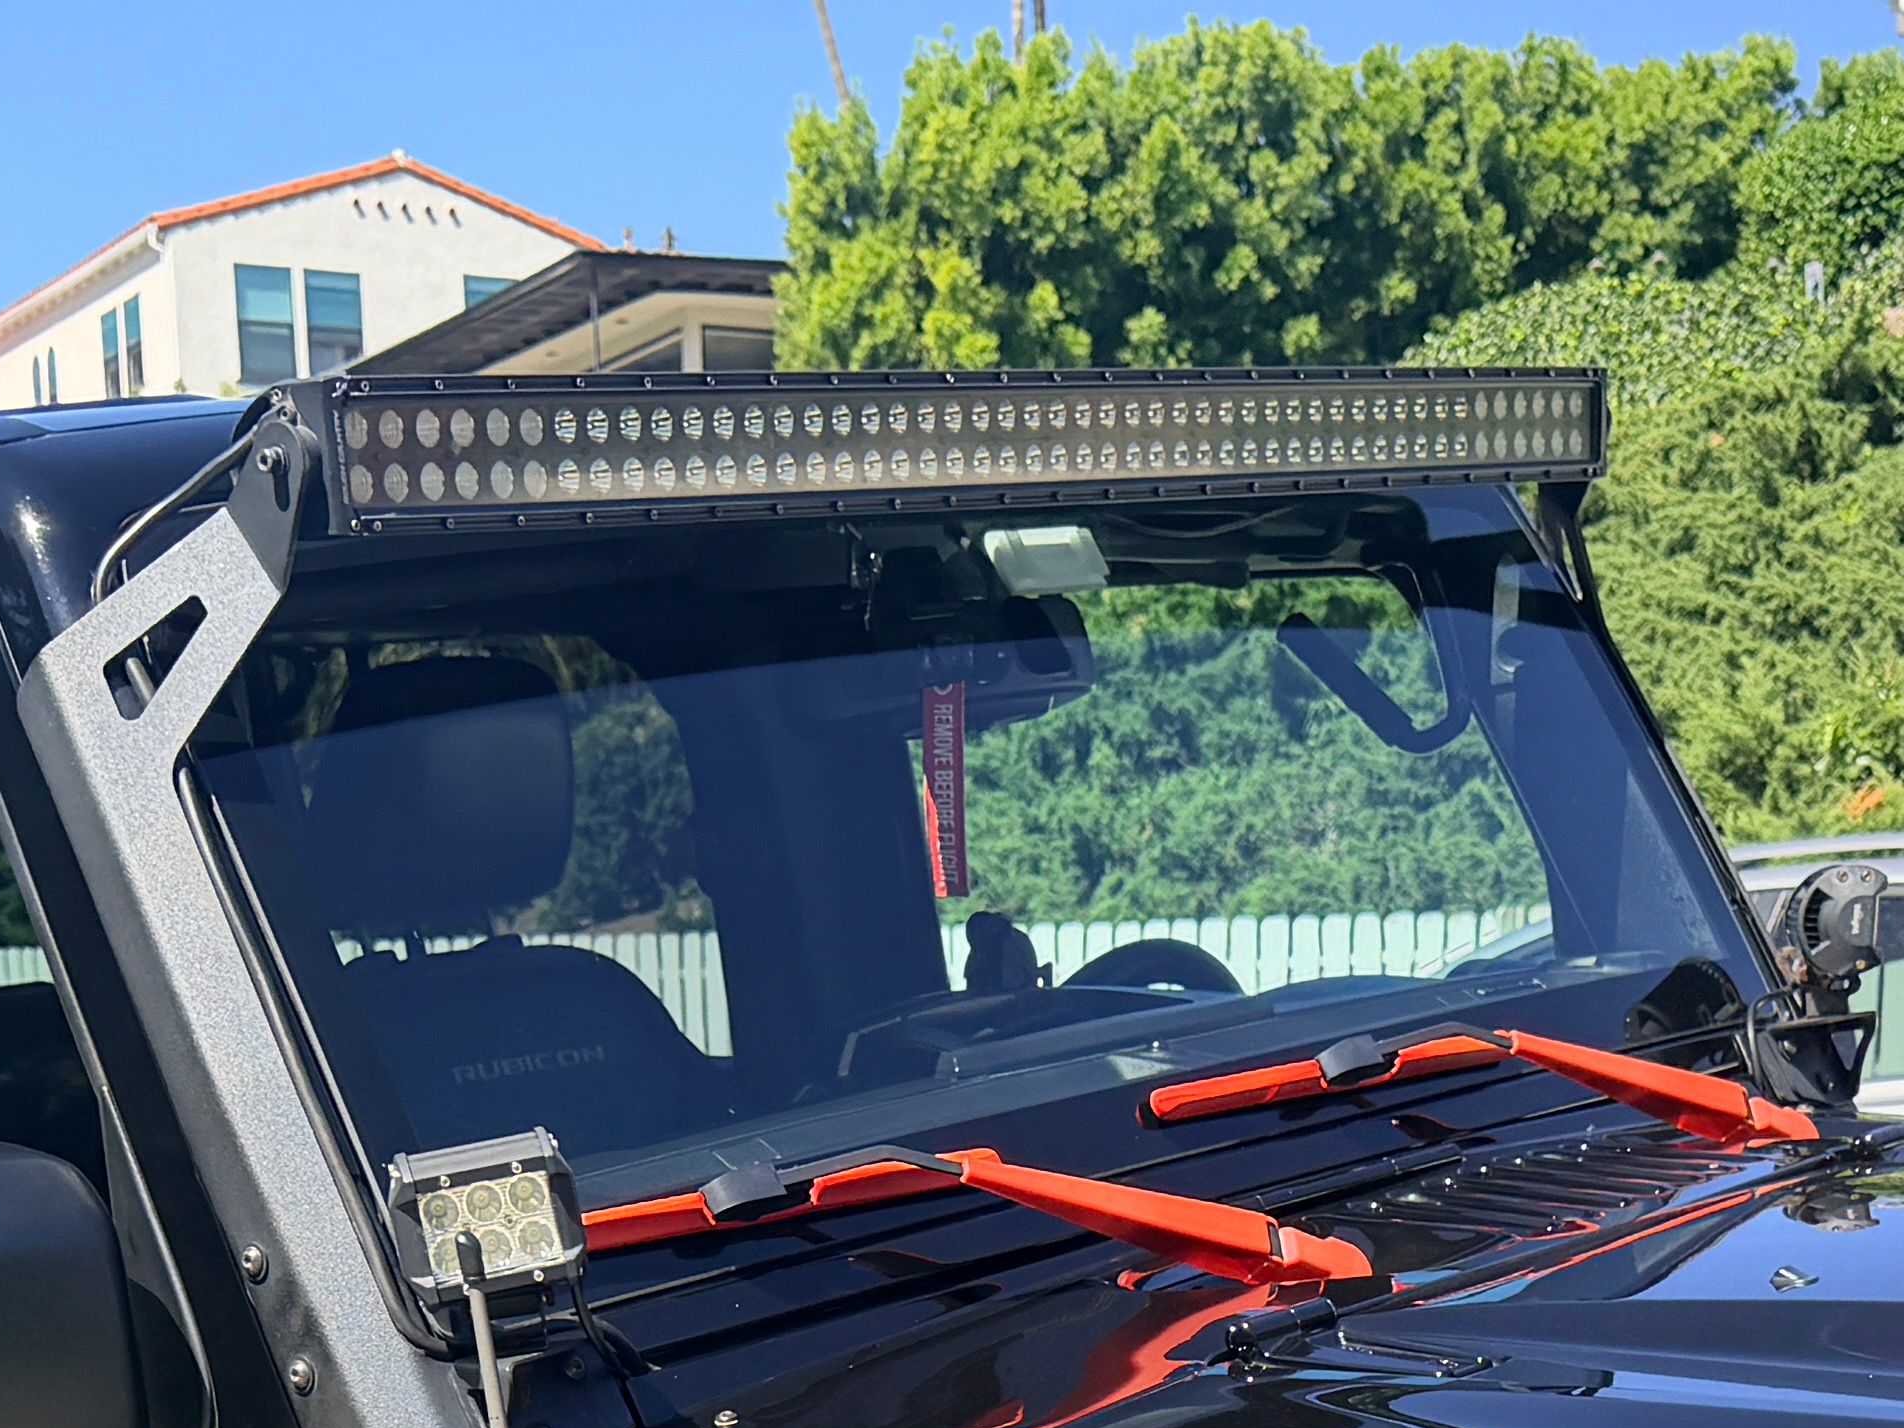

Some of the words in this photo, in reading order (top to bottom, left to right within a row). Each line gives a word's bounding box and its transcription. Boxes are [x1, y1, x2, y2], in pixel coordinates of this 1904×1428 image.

[933, 703, 954, 767] REMOVE
[934, 769, 955, 830] BEFORE
[450, 1043, 607, 1086] RUBICON
